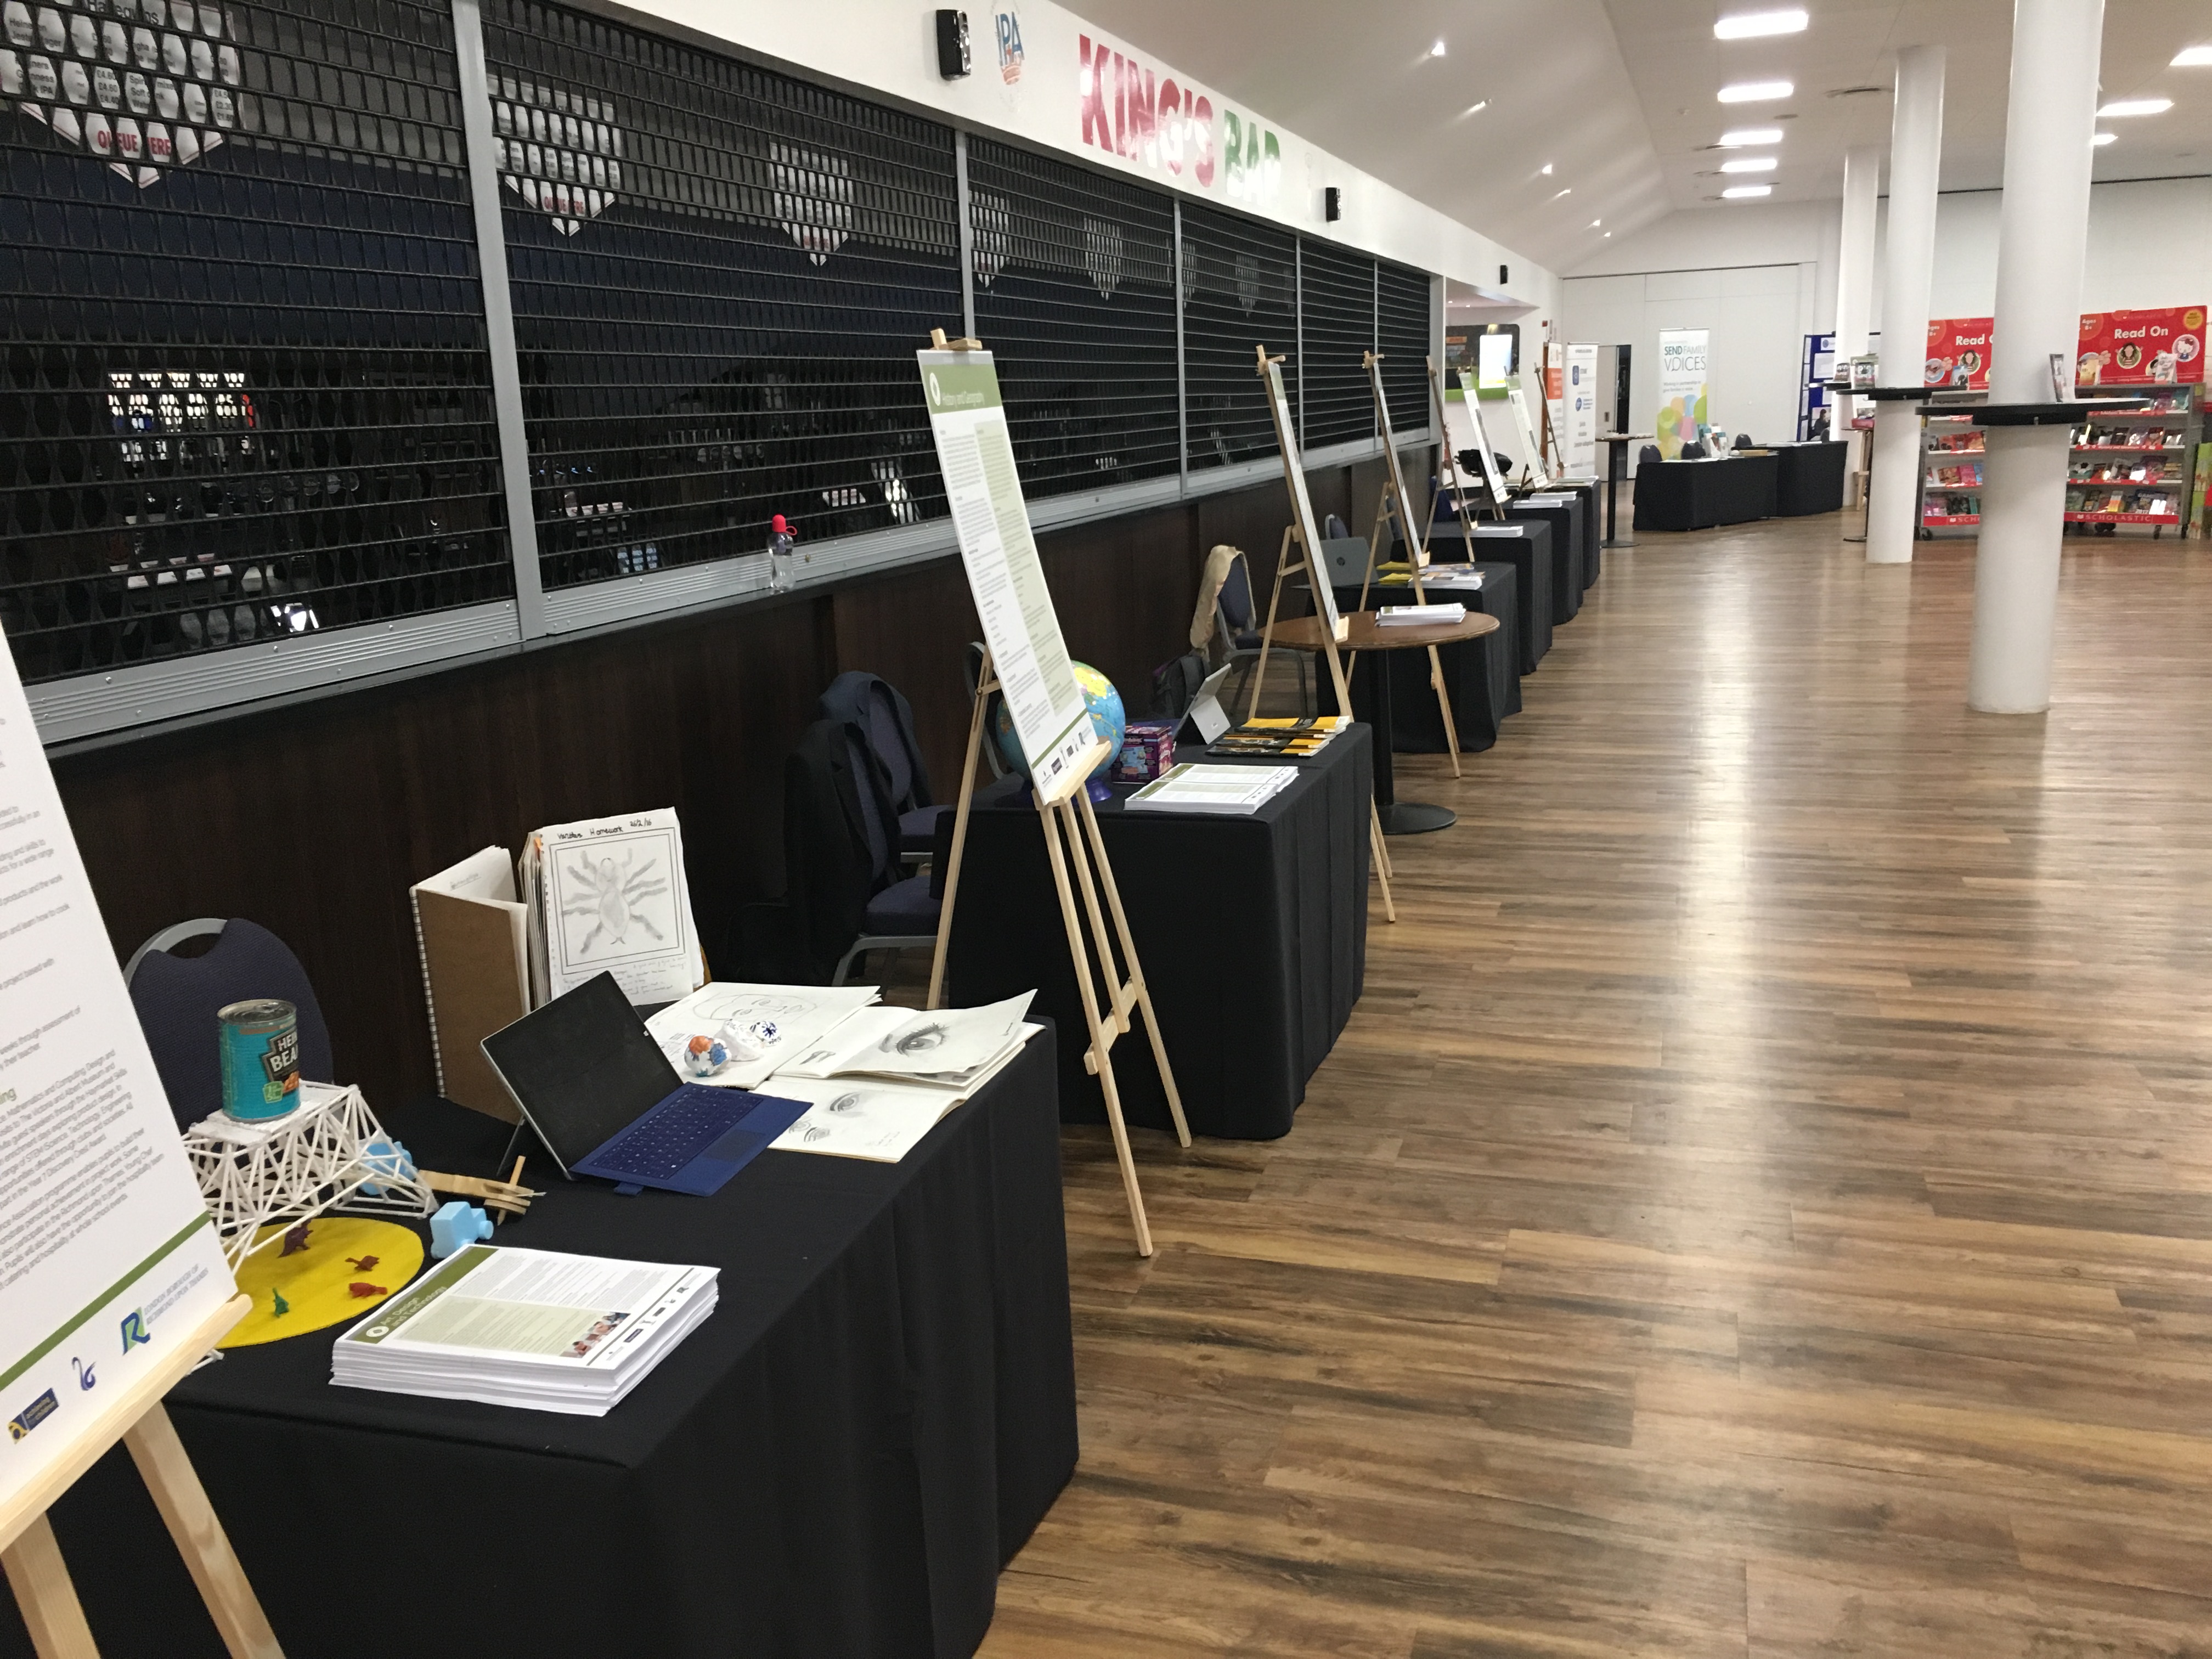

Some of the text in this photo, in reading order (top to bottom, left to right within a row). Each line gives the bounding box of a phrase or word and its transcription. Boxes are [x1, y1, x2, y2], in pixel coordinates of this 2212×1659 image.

[995, 12, 1024, 66] IPA
[1080, 33, 1214, 188] KING'S
[1956, 334, 1985, 346] Read
[2114, 326, 2146, 339] Read
[2150, 326, 2169, 337] On
[1664, 345, 1706, 356] SEND FAMILY
[1664, 356, 1706, 372] VOICES
[589, 826, 623, 836] Homework
[392, 1298, 420, 1315] Design
[403, 1286, 447, 1315] Technology
